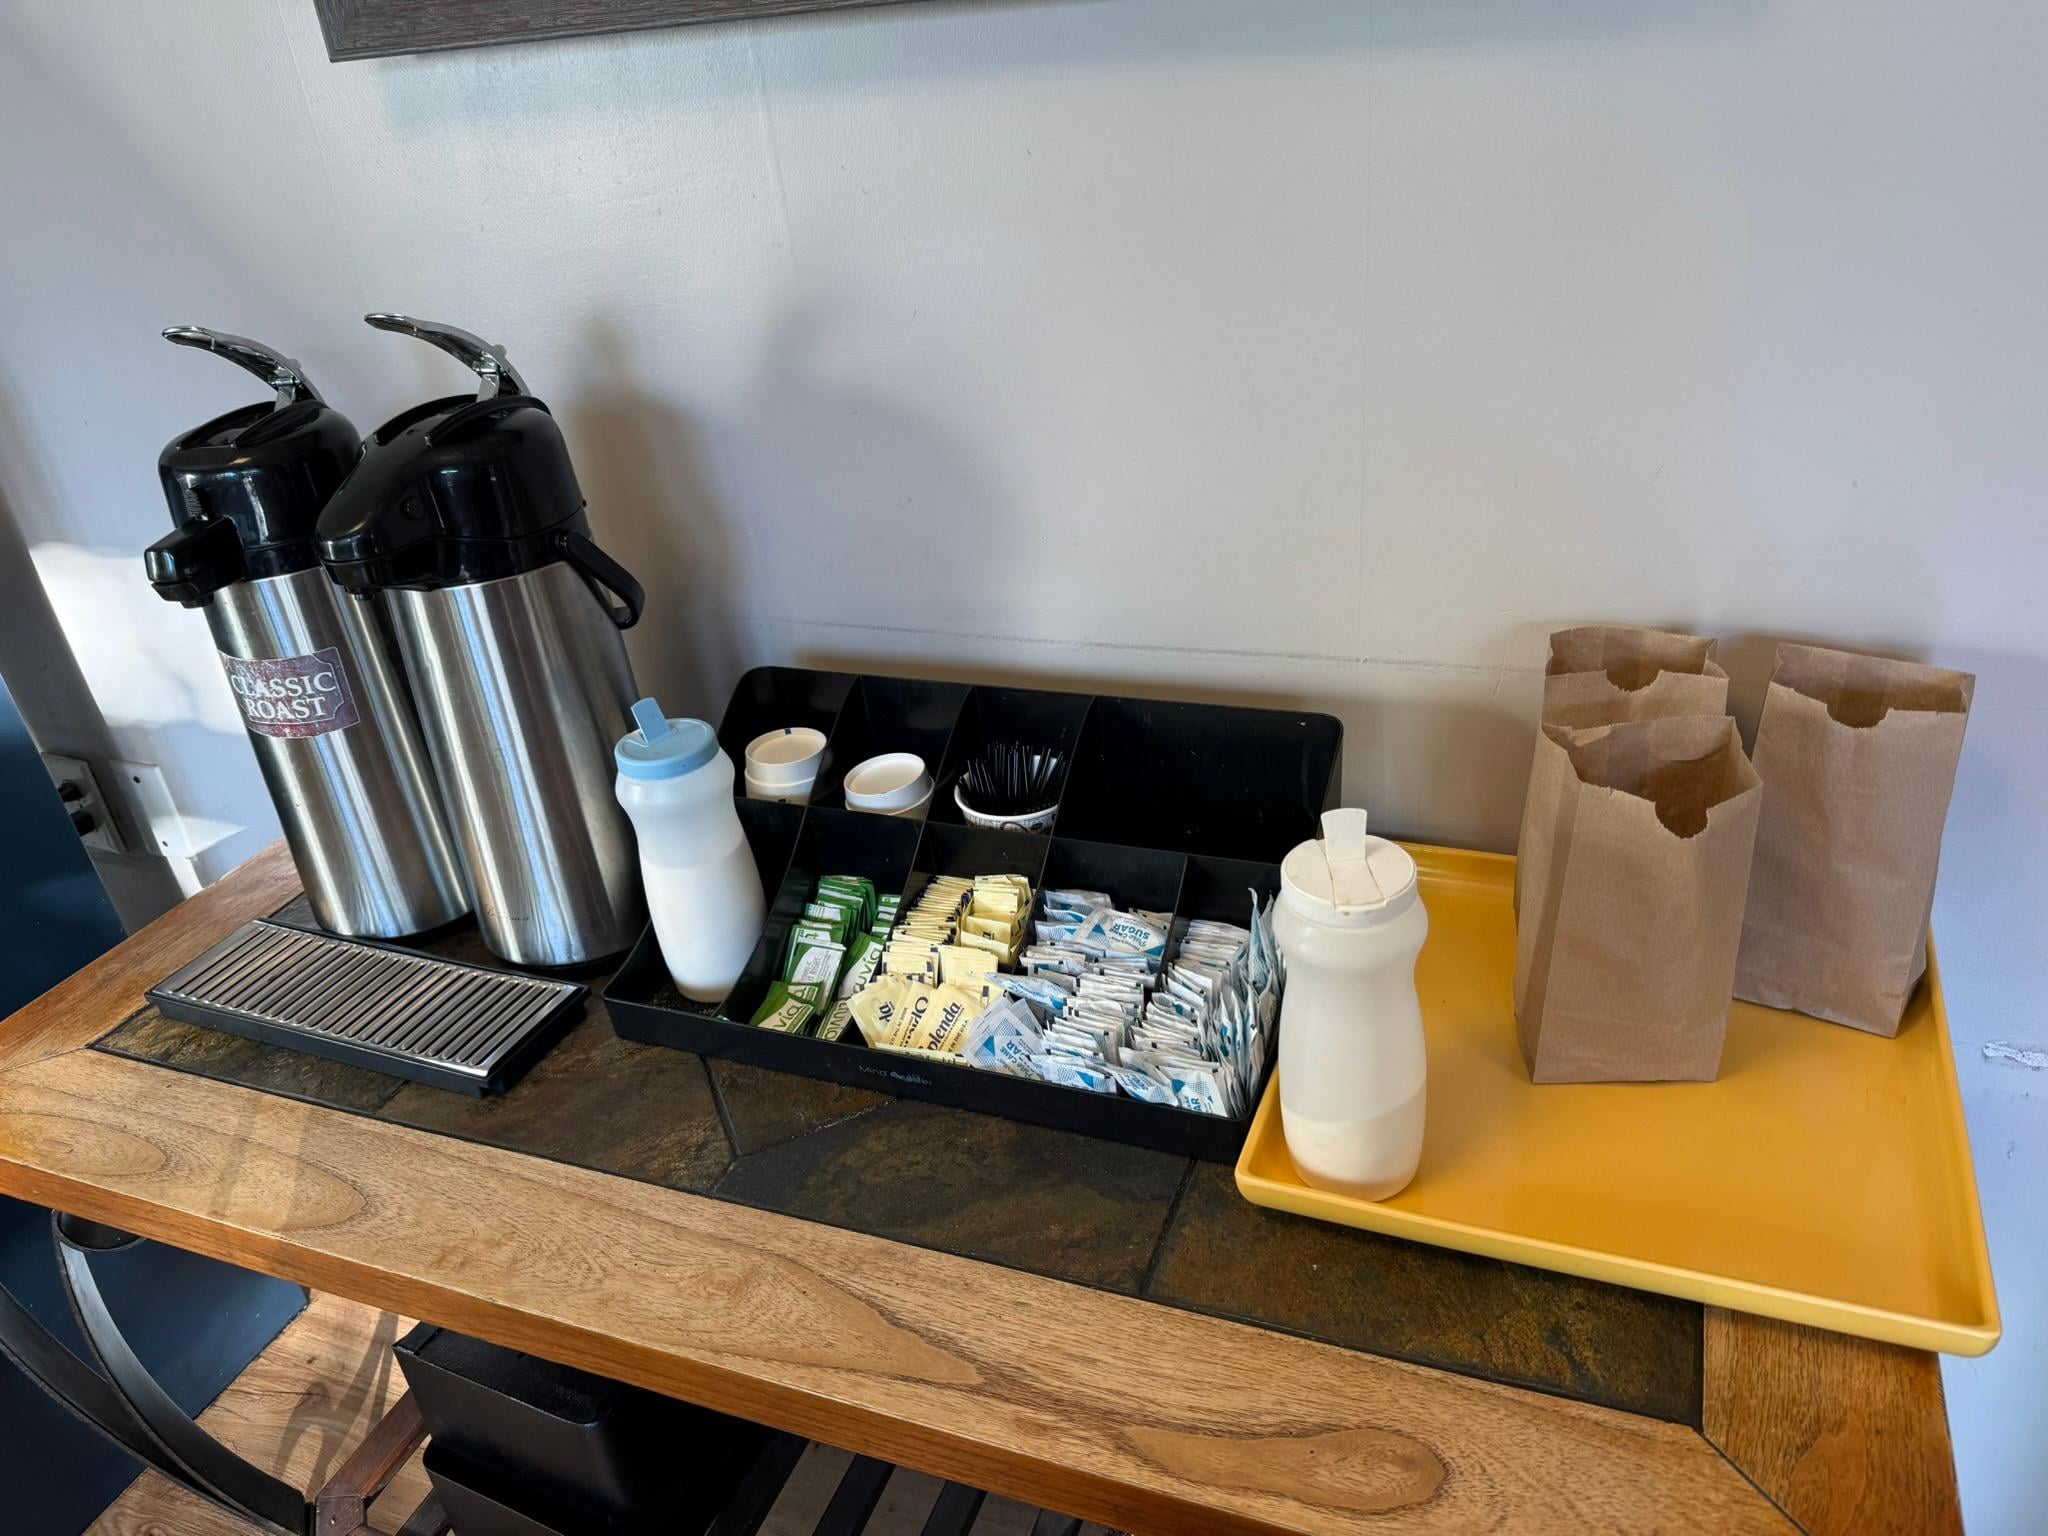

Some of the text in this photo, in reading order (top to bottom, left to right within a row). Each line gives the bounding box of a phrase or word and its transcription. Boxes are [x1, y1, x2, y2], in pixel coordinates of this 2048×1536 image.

[231, 671, 336, 698] CLASSIC
[244, 696, 326, 720] ROAST
[1113, 922, 1150, 939] SUGAR
[853, 946, 881, 993] ruvia
[772, 1003, 803, 1026] via
[921, 1001, 960, 1050] plenda
[999, 1045, 1018, 1064] CANE
